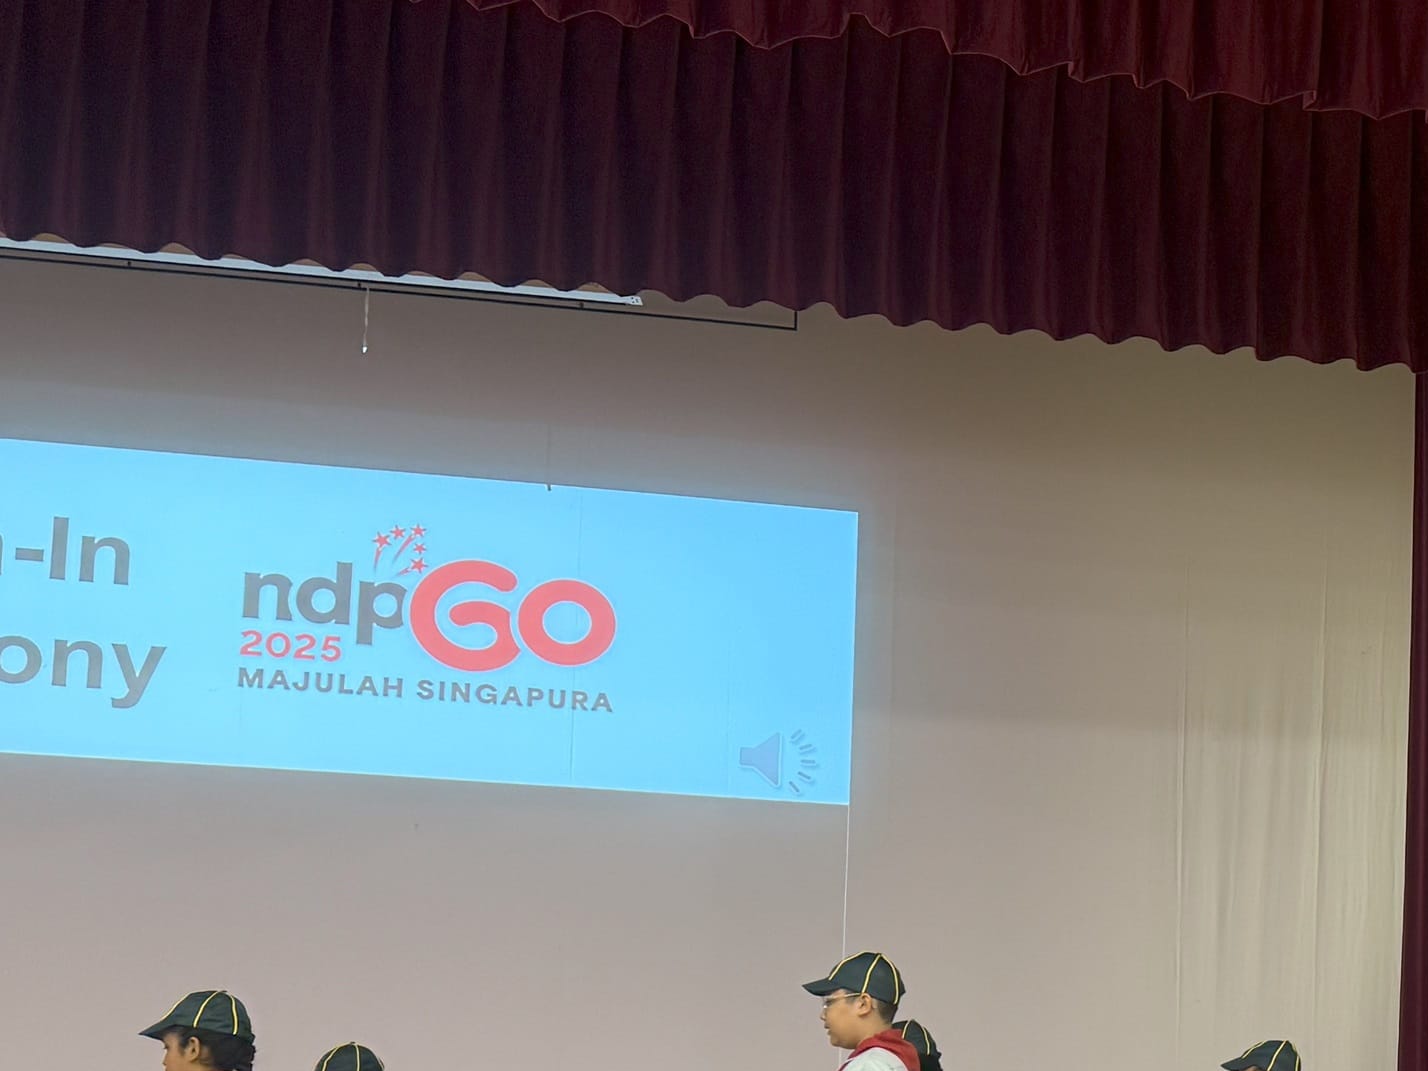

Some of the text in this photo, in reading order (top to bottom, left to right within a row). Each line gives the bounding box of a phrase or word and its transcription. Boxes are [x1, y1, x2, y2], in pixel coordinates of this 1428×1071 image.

[0, 516, 131, 585] -In
[240, 630, 342, 662] 2025
[237, 666, 613, 713] MAJULAH SINGAPURA
